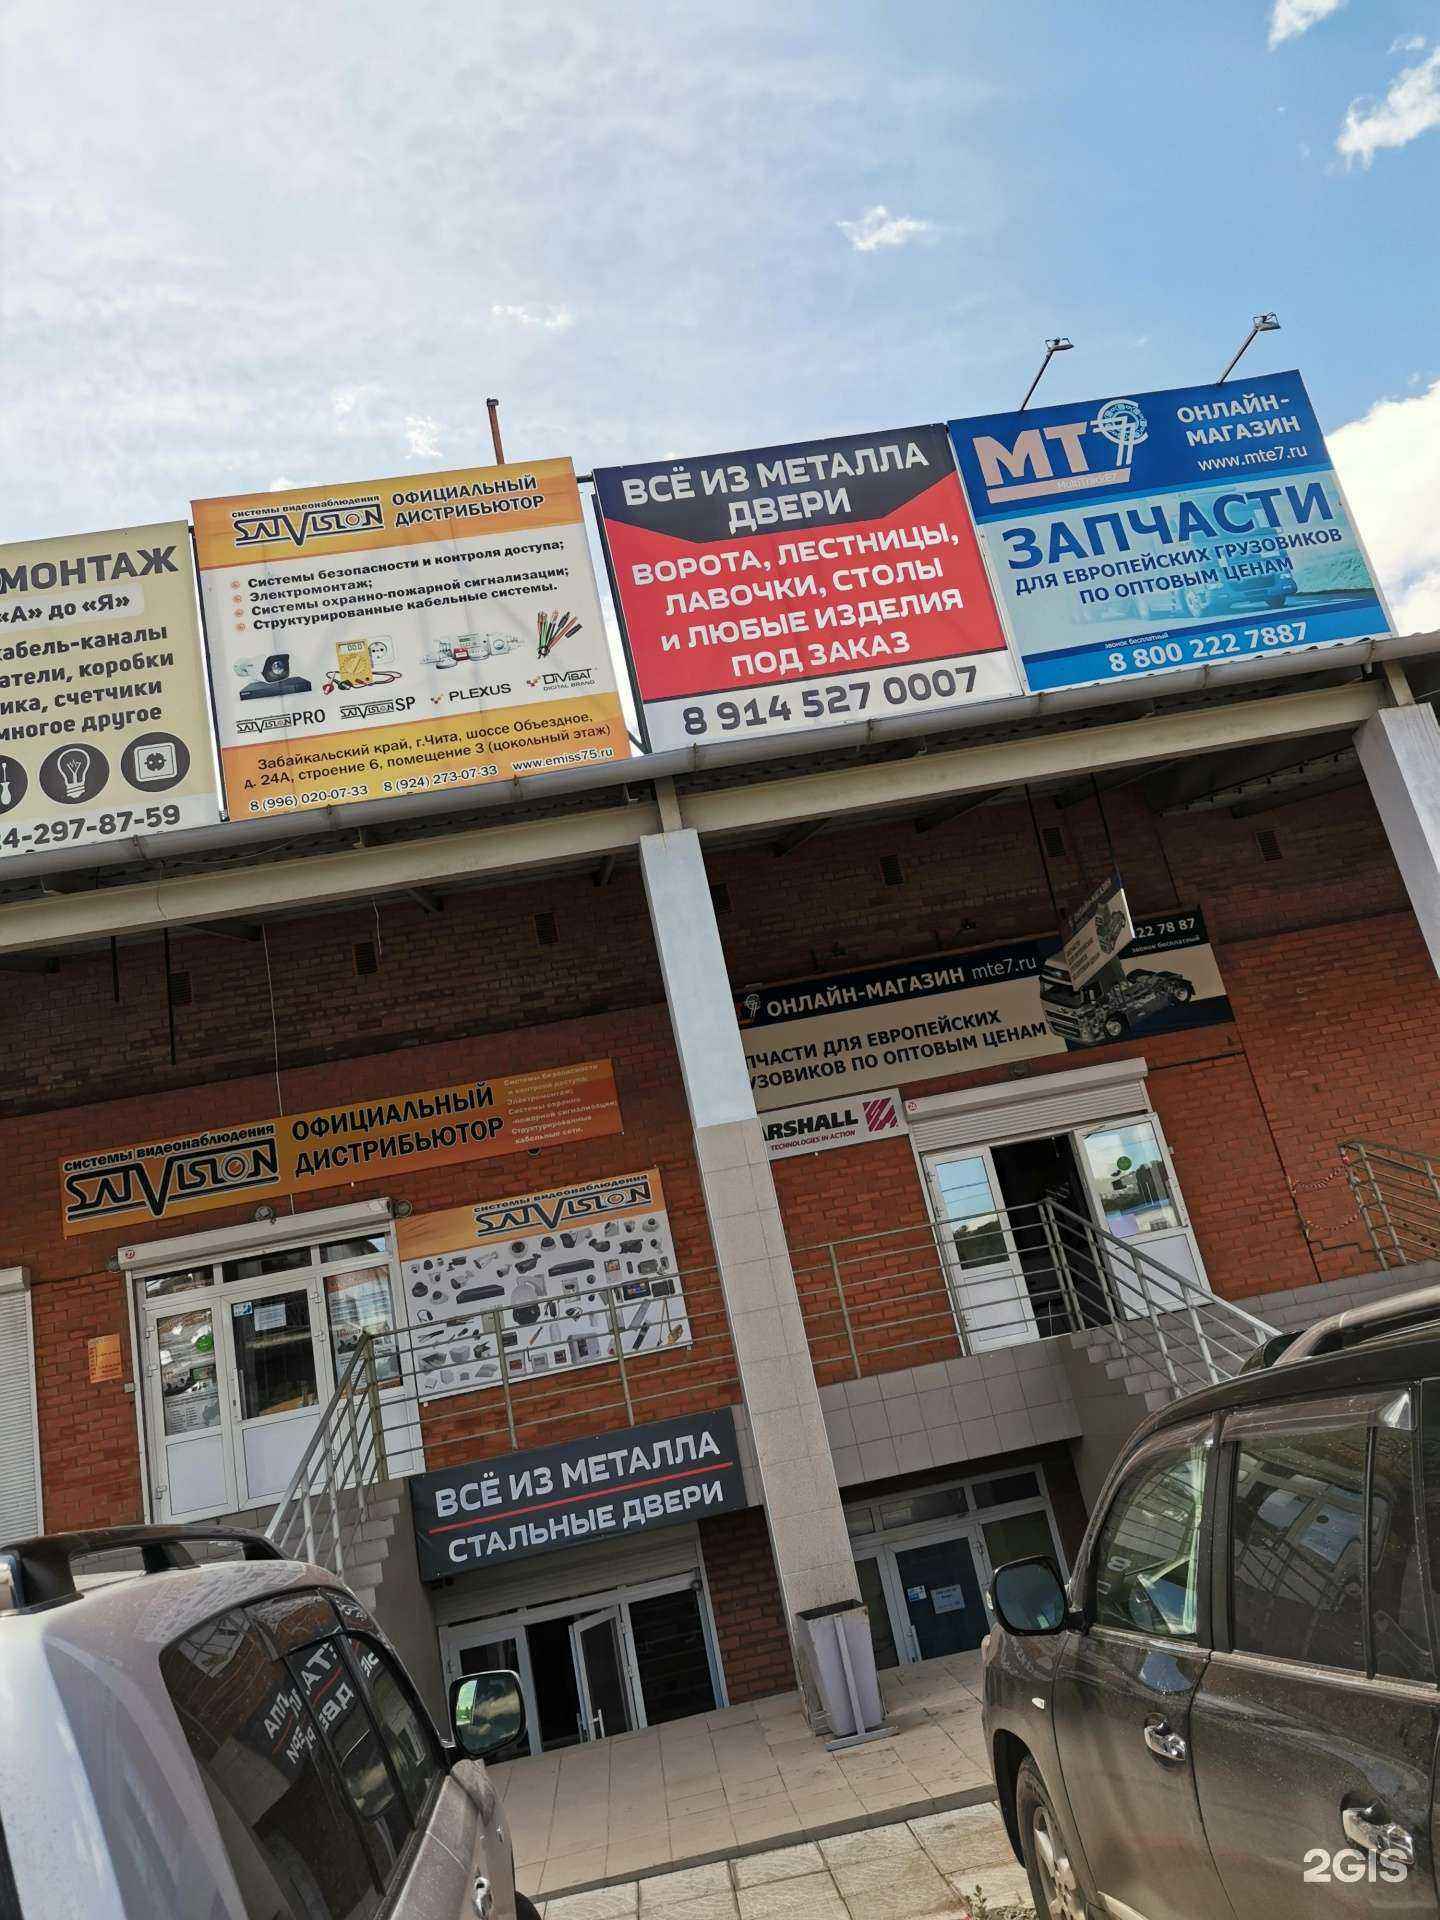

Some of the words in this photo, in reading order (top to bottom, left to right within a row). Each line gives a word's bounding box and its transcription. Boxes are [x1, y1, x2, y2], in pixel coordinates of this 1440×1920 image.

[1176, 393, 1290, 425] ОНЛАЙН-
[1186, 416, 1301, 448] МАГАЗИН
[622, 466, 695, 506] ВСЁ
[699, 466, 749, 497] ИЗ
[756, 441, 930, 488] МЕТАЛЛА
[1198, 444, 1308, 472] www.mte7.ru
[231, 507, 280, 518] системы
[282, 495, 380, 513] видеонаблюдения
[392, 474, 537, 506] ОФИЦИАЛЬНЫЙ
[395, 495, 544, 527] ДИСТРИБЬЮТОР
[728, 488, 852, 535] ДВЕРИ
[1002, 481, 1334, 571] ЗАПЧАСТИ
[248, 572, 315, 588] Системы
[318, 559, 419, 580] безопасности
[422, 557, 431, 566] и
[435, 548, 501, 565] контроля
[504, 540, 564, 557] доступа;
[632, 549, 770, 586] ВОРОТА,
[778, 523, 959, 567] ЛЕСТНИЦЫ,
[1015, 573, 1059, 596] ДЛЯ
[1064, 547, 1210, 586] ЕВРОПЕЙСКИХ
[1214, 528, 1342, 561] ГРУЗОВИКОВ
[249, 579, 373, 602] Электромонтаж;
[252, 599, 318, 616] Системы
[322, 578, 461, 607] охранно-пожарной
[464, 567, 569, 588] сигнализации;
[665, 574, 828, 616] ЛАВОЧКИ,
[832, 557, 944, 592] СТОЛЫ
[1079, 585, 1110, 605] ПО
[1114, 569, 1218, 598] ОПТОВЫМ
[1225, 555, 1294, 584] ЦЕНАМ
[48, 603, 77, 621] до
[82, 593, 131, 613] «Я»
[253, 603, 404, 630] Структурированные
[407, 590, 488, 611] кабельные
[491, 581, 558, 598] системы.
[688, 610, 809, 648] ЛЮБЫЕ
[815, 588, 964, 633] ИЗДЕЛИЯ
[79, 652, 174, 679] коробки
[732, 646, 803, 677] ПОД
[808, 632, 911, 665] ЗАКАЗ
[1109, 653, 1127, 672] 8
[1132, 643, 1183, 668] 800
[1189, 633, 1240, 659] 222
[1245, 622, 1307, 649] 7887
[55, 681, 162, 708] счетчики
[395, 696, 416, 712] SP
[449, 683, 512, 702] PLEXUS
[571, 679, 595, 688] BRAND
[683, 707, 708, 736] 8
[717, 696, 792, 731] 914
[803, 683, 872, 719] 527
[882, 665, 978, 706] 0007
[82, 706, 163, 734] другое
[258, 745, 370, 770] Забайкальский
[374, 738, 412, 755] край,
[466, 725, 510, 740] шоссе
[513, 712, 593, 732] Объездное,
[292, 709, 326, 727] PRO
[244, 778, 257, 790] д.
[261, 771, 294, 785] 24А,
[298, 763, 366, 780] строение
[369, 758, 383, 770] 6,
[387, 746, 471, 768] помещение
[475, 742, 485, 754] 3
[488, 729, 570, 754] (цокольный
[573, 723, 611, 739] этаж)
[383, 781, 392, 792] 8
[395, 775, 430, 791] (924)
[433, 765, 498, 785] 273-07-33
[512, 747, 614, 771] www.emiss75.ru
[250, 801, 259, 811] 8
[263, 795, 298, 812] (996)
[301, 785, 368, 803] 020-07-33
[0, 804, 180, 848] 4-297-87-59
[1159, 922, 1176, 935] 78
[1178, 918, 1195, 931] 87
[767, 967, 965, 1018] ОНЛАЙН-МАГАЗИН
[971, 956, 1037, 980] mte7.ru
[823, 1036, 863, 1058] ДЛЯ
[867, 1009, 1002, 1047] ЕВРОПЕЙСКИХ
[851, 1054, 878, 1071] ПО
[884, 1035, 978, 1065] ОПТОВЫМ
[983, 1022, 1048, 1047] ЦЕНАМ
[291, 1081, 494, 1141] ОФИЦИАЛЬНЫЙ
[63, 1149, 133, 1172] системы
[136, 1124, 275, 1158] видеонаблюдения
[295, 1116, 504, 1178] ДИСТРИБЬЮТОР
[771, 1136, 821, 1151] TECHNOLOGIES
[821, 1134, 829, 1142] IN
[829, 1129, 856, 1141] ACTION
[473, 1199, 530, 1213] системы
[533, 1174, 648, 1201] видеонаблюдения
[435, 1470, 503, 1518] ВСЁ
[509, 1467, 553, 1501] ИЗ
[560, 1431, 721, 1489] МЕТАЛЛА
[448, 1504, 616, 1563] СТАЛЬНЫЕ
[622, 1480, 724, 1530] ДВЕРИ
